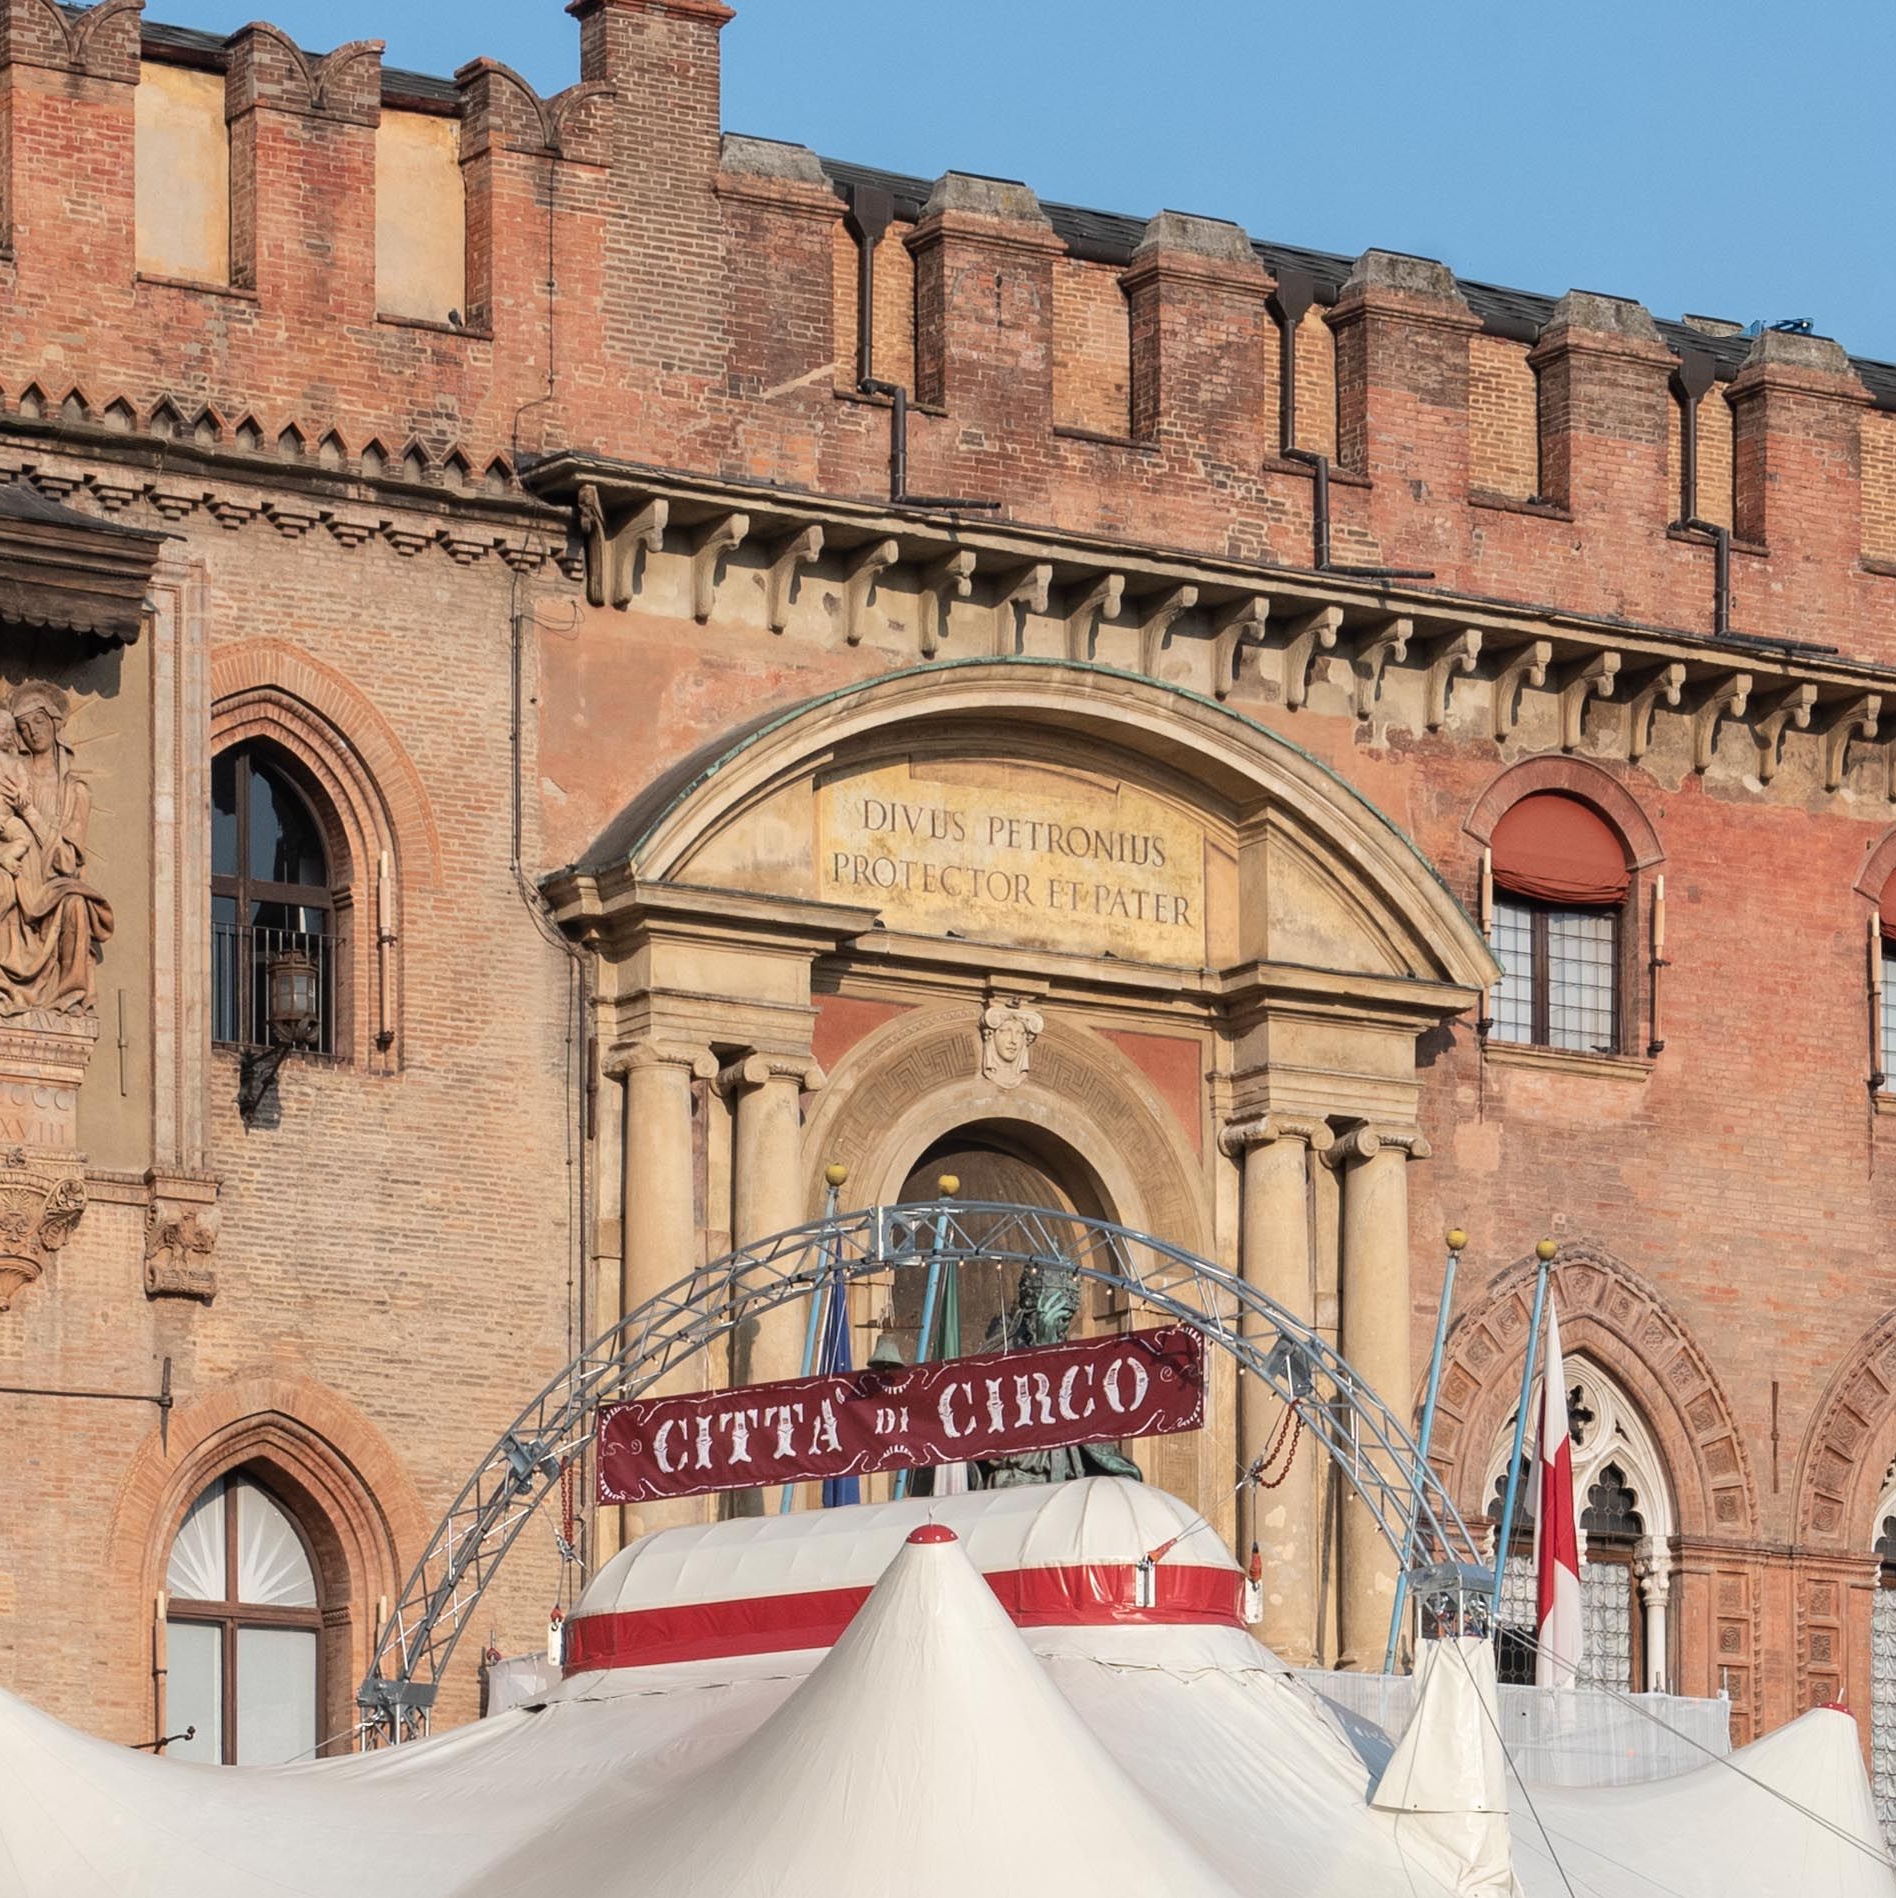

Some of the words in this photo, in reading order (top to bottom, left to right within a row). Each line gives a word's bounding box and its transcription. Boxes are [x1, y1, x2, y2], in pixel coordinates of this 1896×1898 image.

[863, 799, 966, 842] DIVUS
[987, 815, 1167, 868] PETRONIUS
[832, 852, 1036, 906] PROTECTOR
[1049, 878, 1085, 911] ET
[1094, 884, 1194, 929] PATER
[874, 1405, 910, 1436] DI
[938, 1356, 1150, 1439] CIRCO
